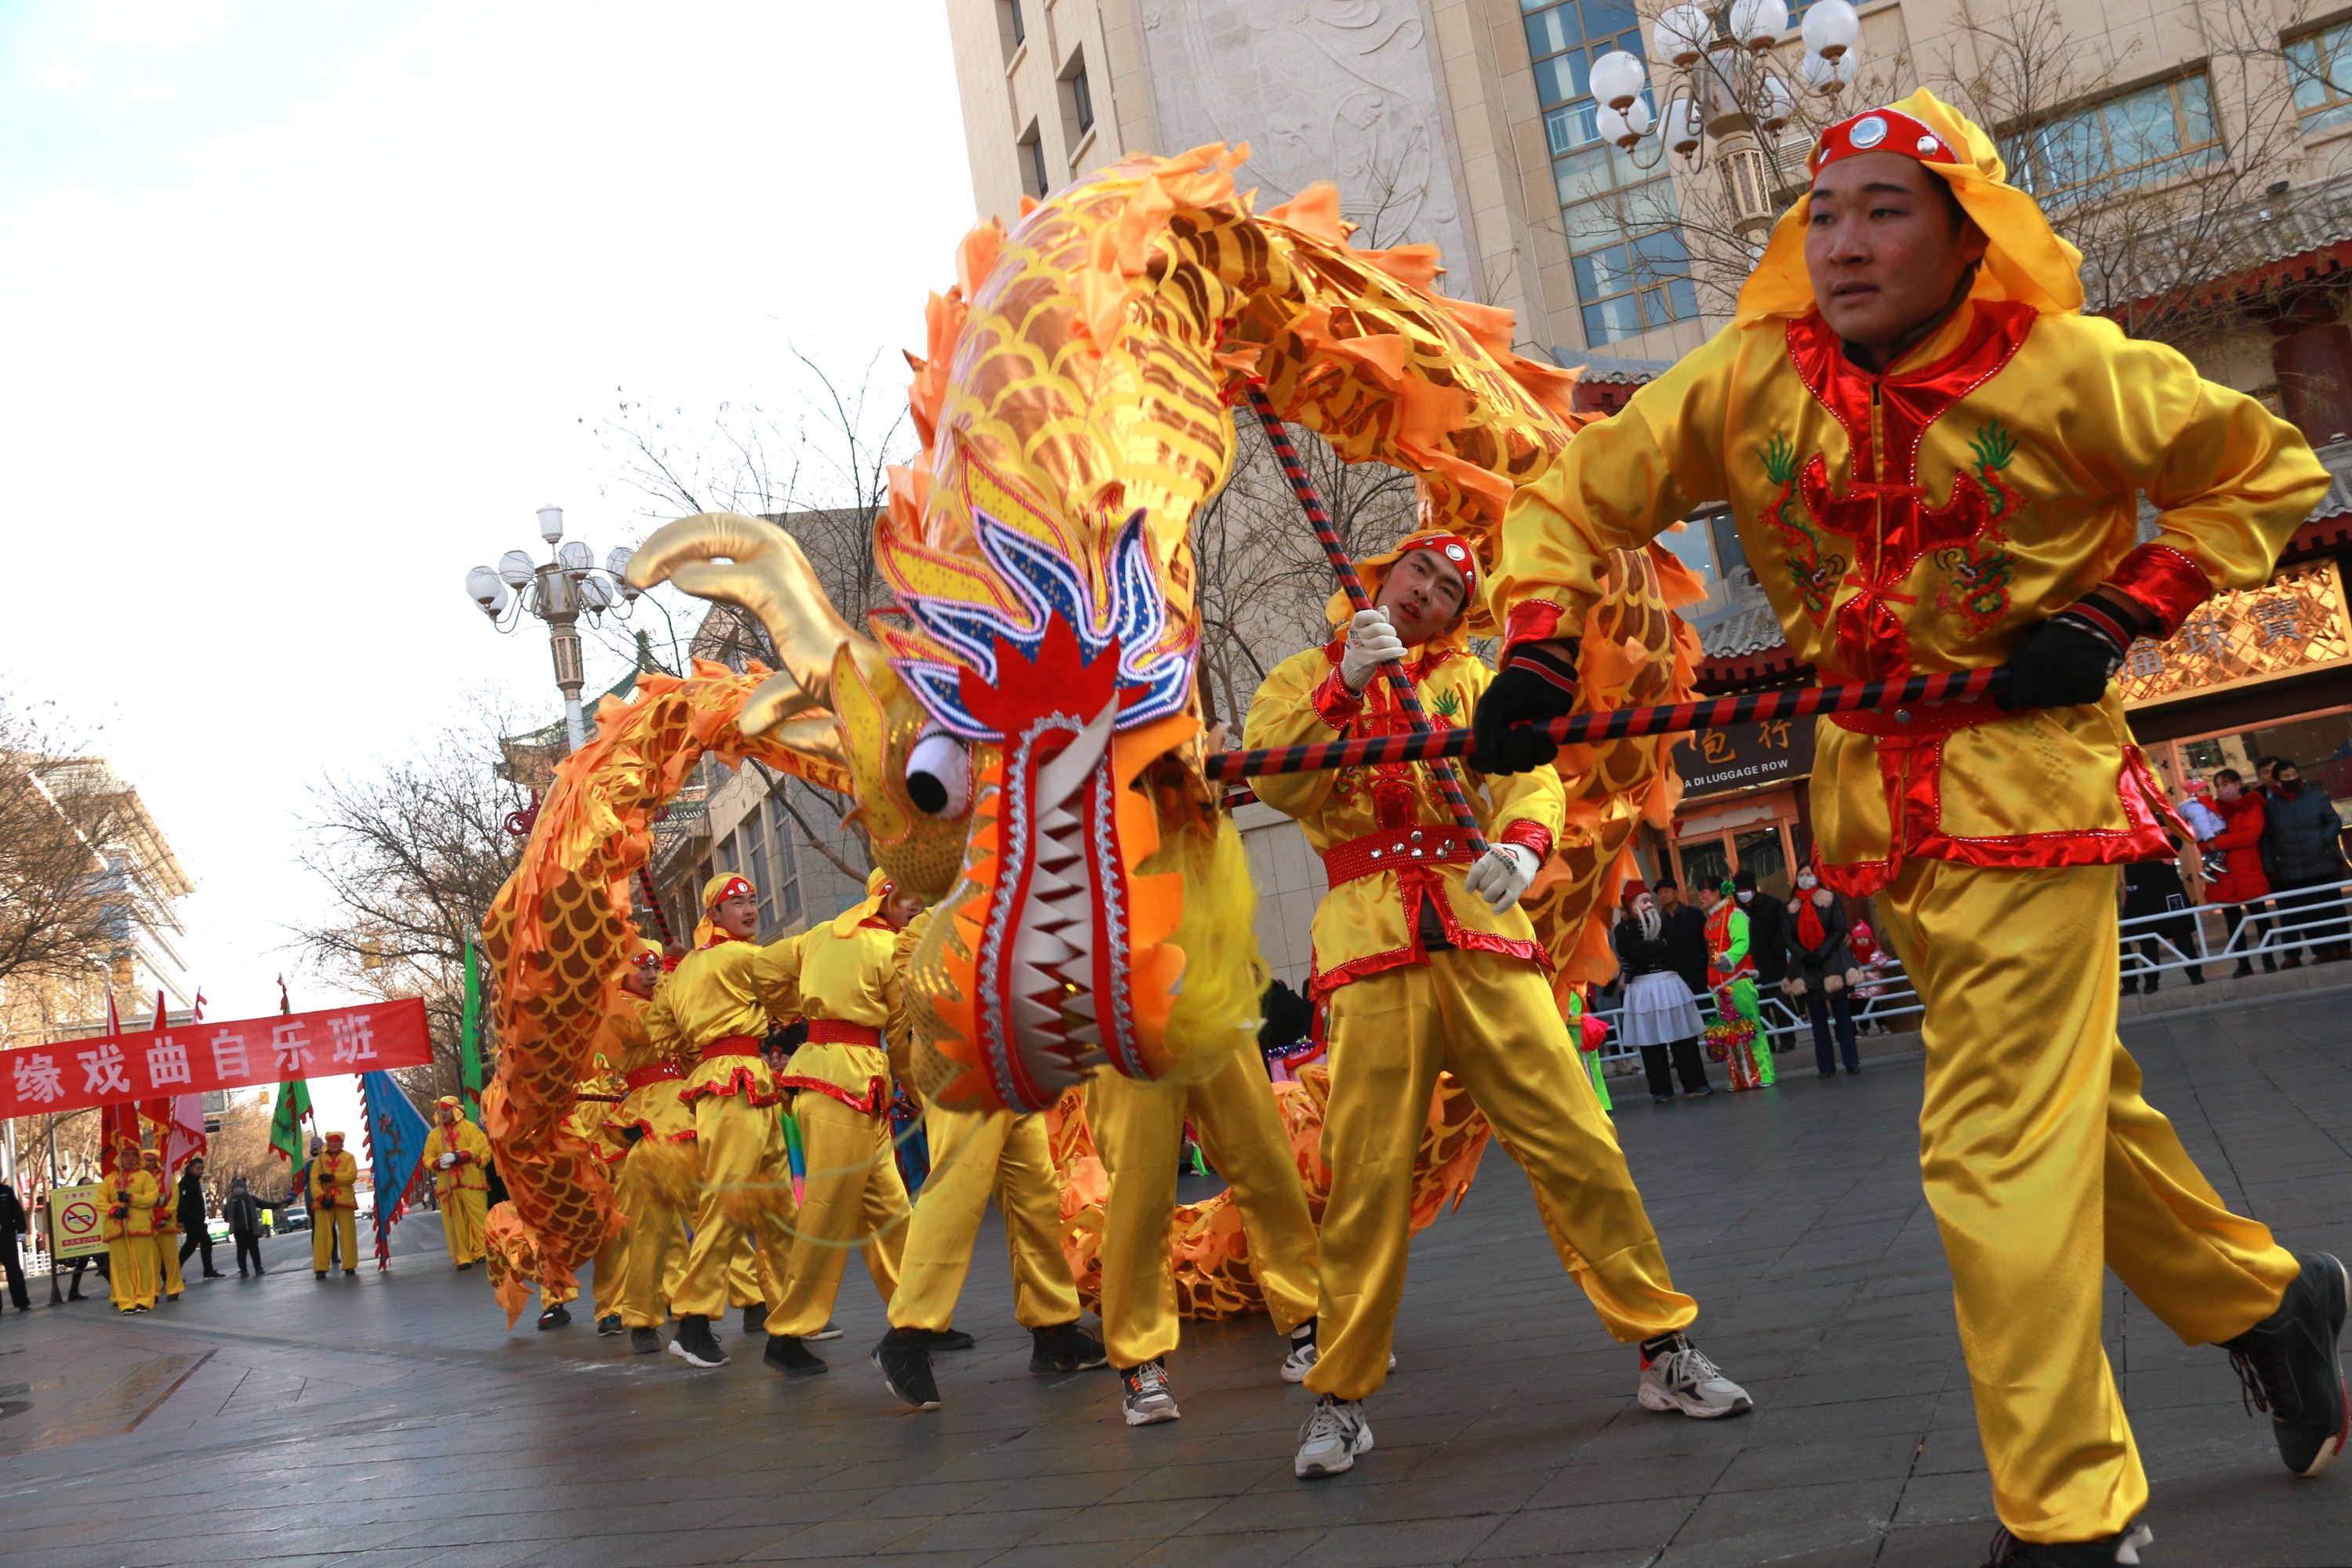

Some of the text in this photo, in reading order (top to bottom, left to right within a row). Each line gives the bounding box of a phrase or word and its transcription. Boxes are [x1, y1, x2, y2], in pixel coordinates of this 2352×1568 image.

[1701, 719, 1792, 764] 包行
[1693, 776, 1704, 786] DI
[1706, 765, 1759, 784] LUGGAGE
[1761, 759, 1788, 772] ROW
[13, 1013, 377, 1104] 缘戏曲自乐班
